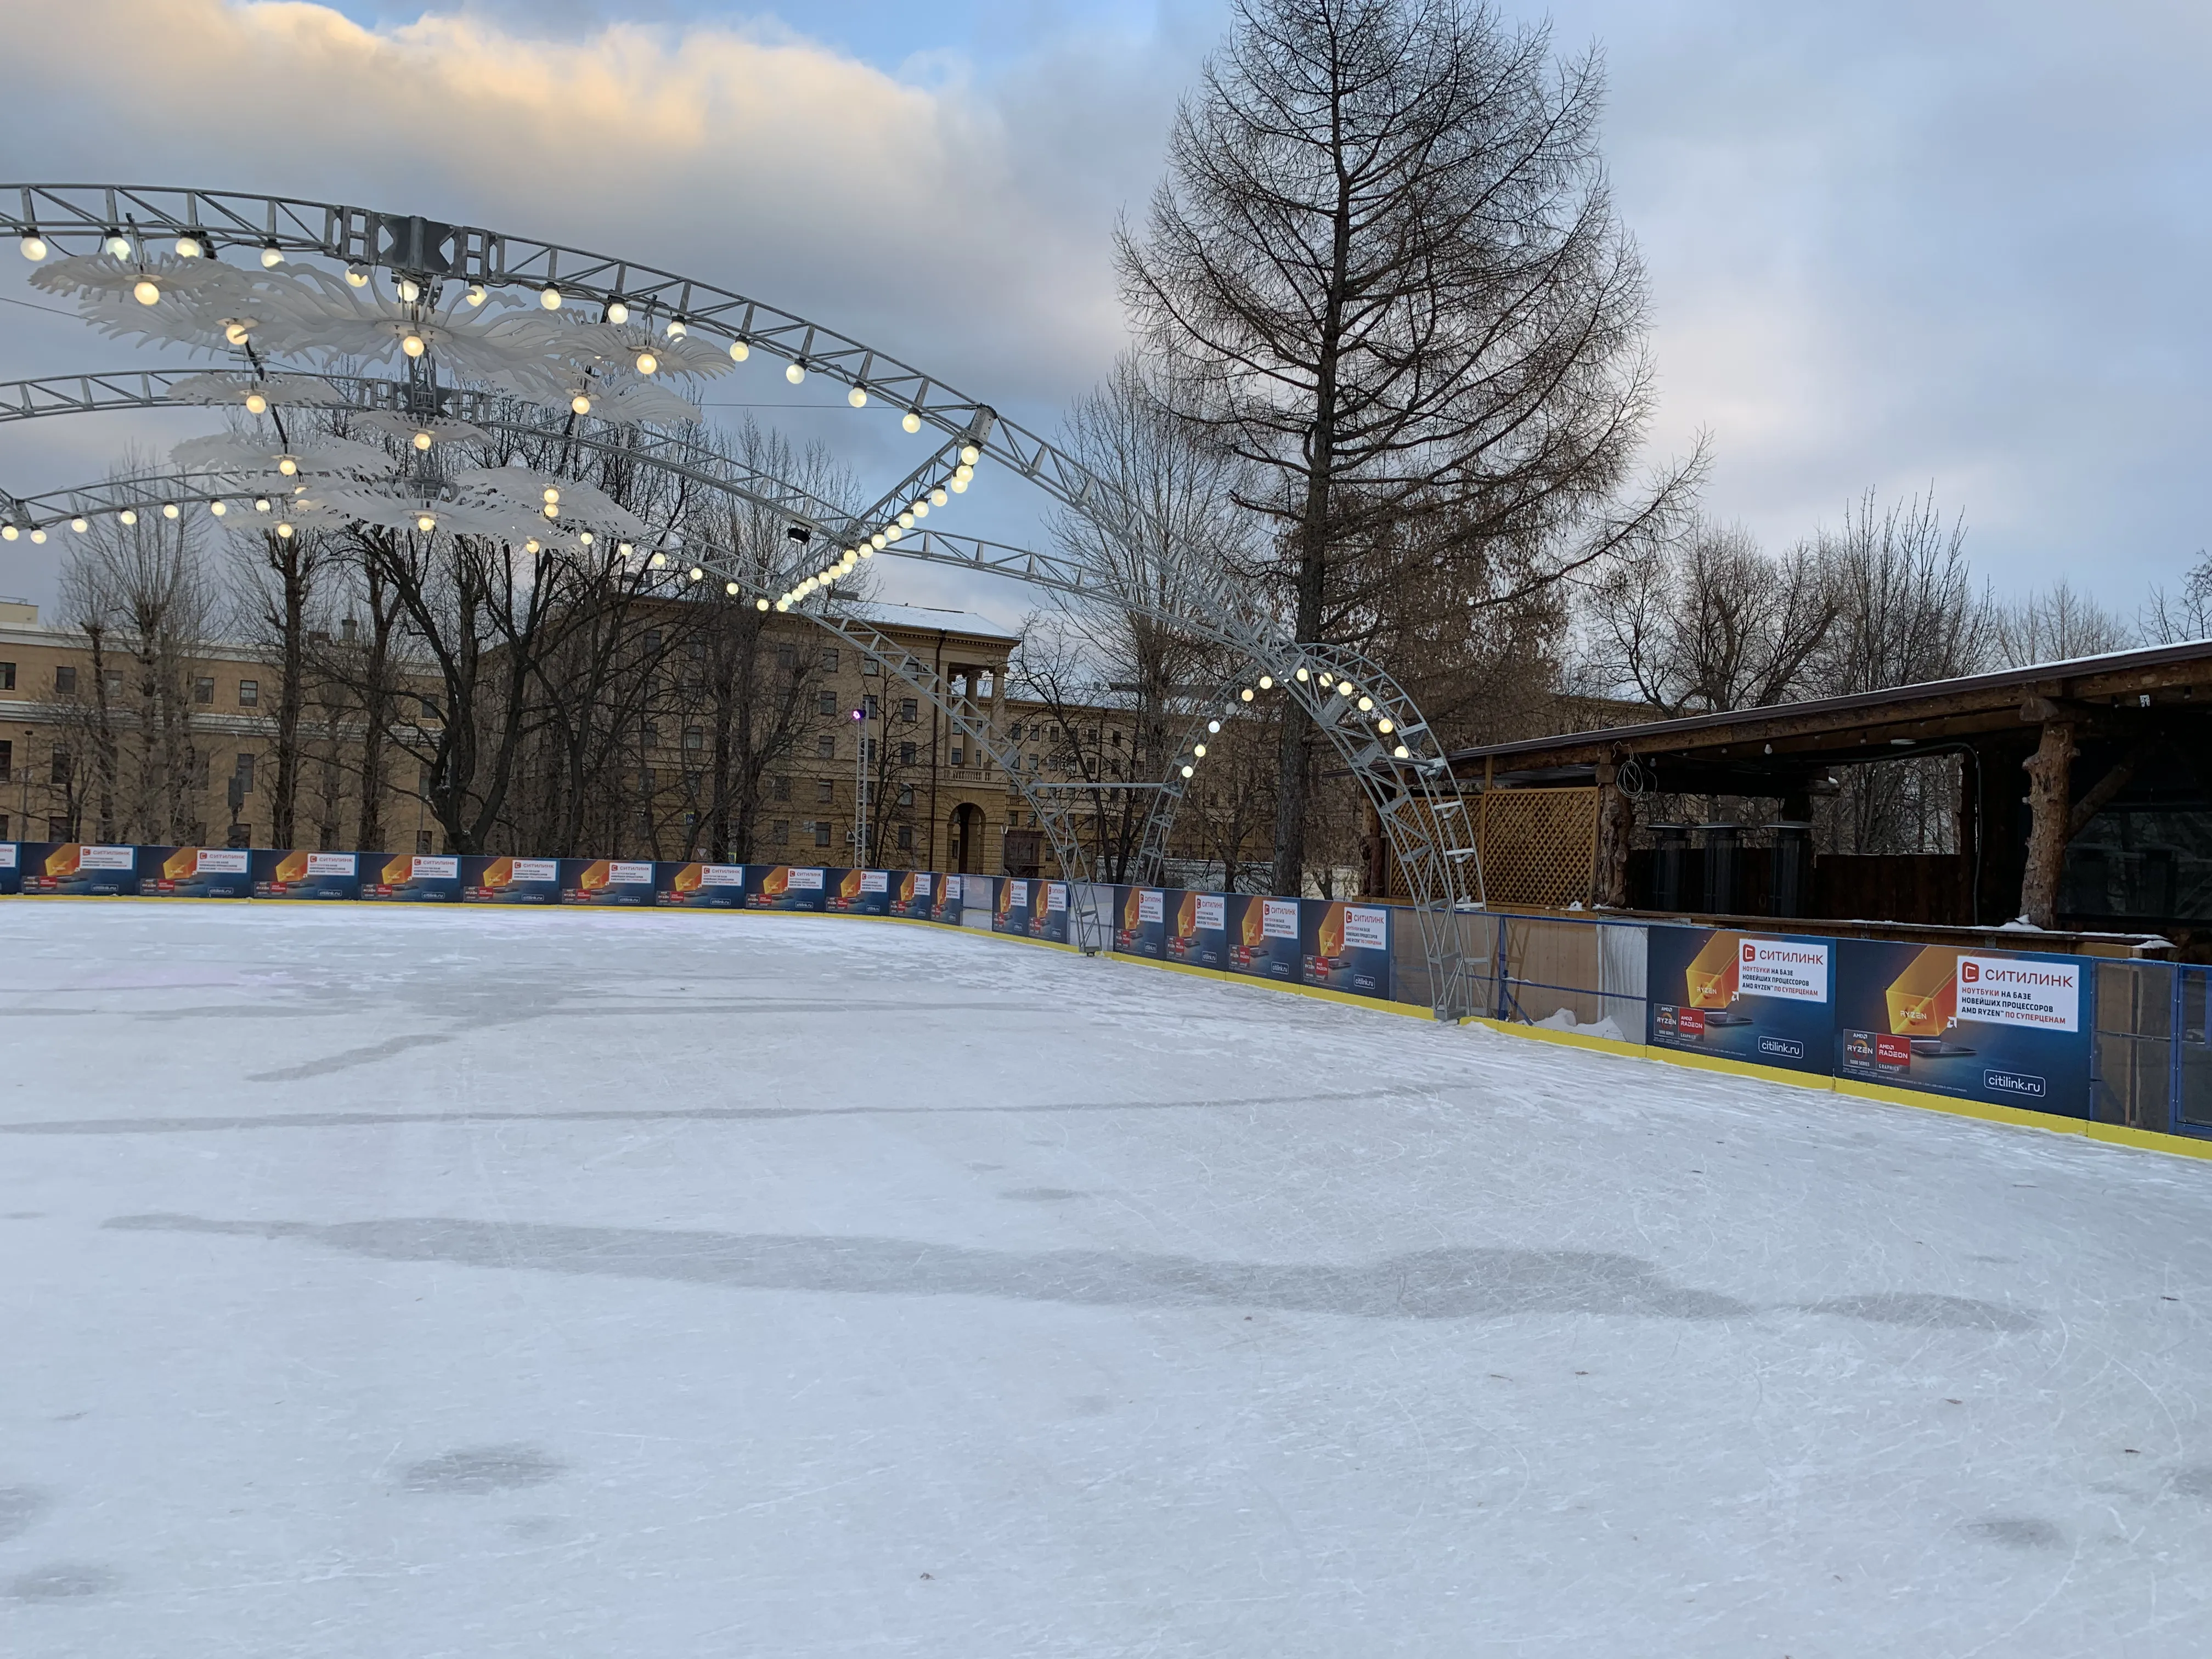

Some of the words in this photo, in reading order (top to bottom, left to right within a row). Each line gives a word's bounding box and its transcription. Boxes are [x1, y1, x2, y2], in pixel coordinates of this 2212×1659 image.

[1354, 914, 1384, 924] СИТИЛИНК
[1759, 950, 1824, 965] СИТИЛИНК
[1742, 974, 1771, 983] НОВЕЙШИХ
[1772, 977, 1809, 986] ПРОЦЕССОРОВ
[1985, 969, 2074, 988] СИТИЛИНК
[1697, 986, 1717, 995] RYZEN
[1782, 986, 1818, 996] СУПЕРЦЕНАМ
[1962, 987, 1999, 997] НОУТБУКИ
[2013, 992, 2032, 1000] БАЗЕ
[1962, 997, 2001, 1007] НОВЕЙШИХ
[2002, 1001, 2053, 1013] ПРОЦЕССОРОВ
[1900, 1010, 1927, 1020] RYZEN
[2016, 1013, 2066, 1024] СУПЕРЦЕНАМ
[1657, 1017, 1677, 1025] RYZEN
[1680, 1020, 1703, 1029] RADEON
[1762, 1040, 1799, 1054] citilink.ru
[1847, 1044, 1873, 1054] RYZEN
[1878, 1049, 1908, 1059] RADEON
[1988, 1075, 2040, 1092] citilink.ru
